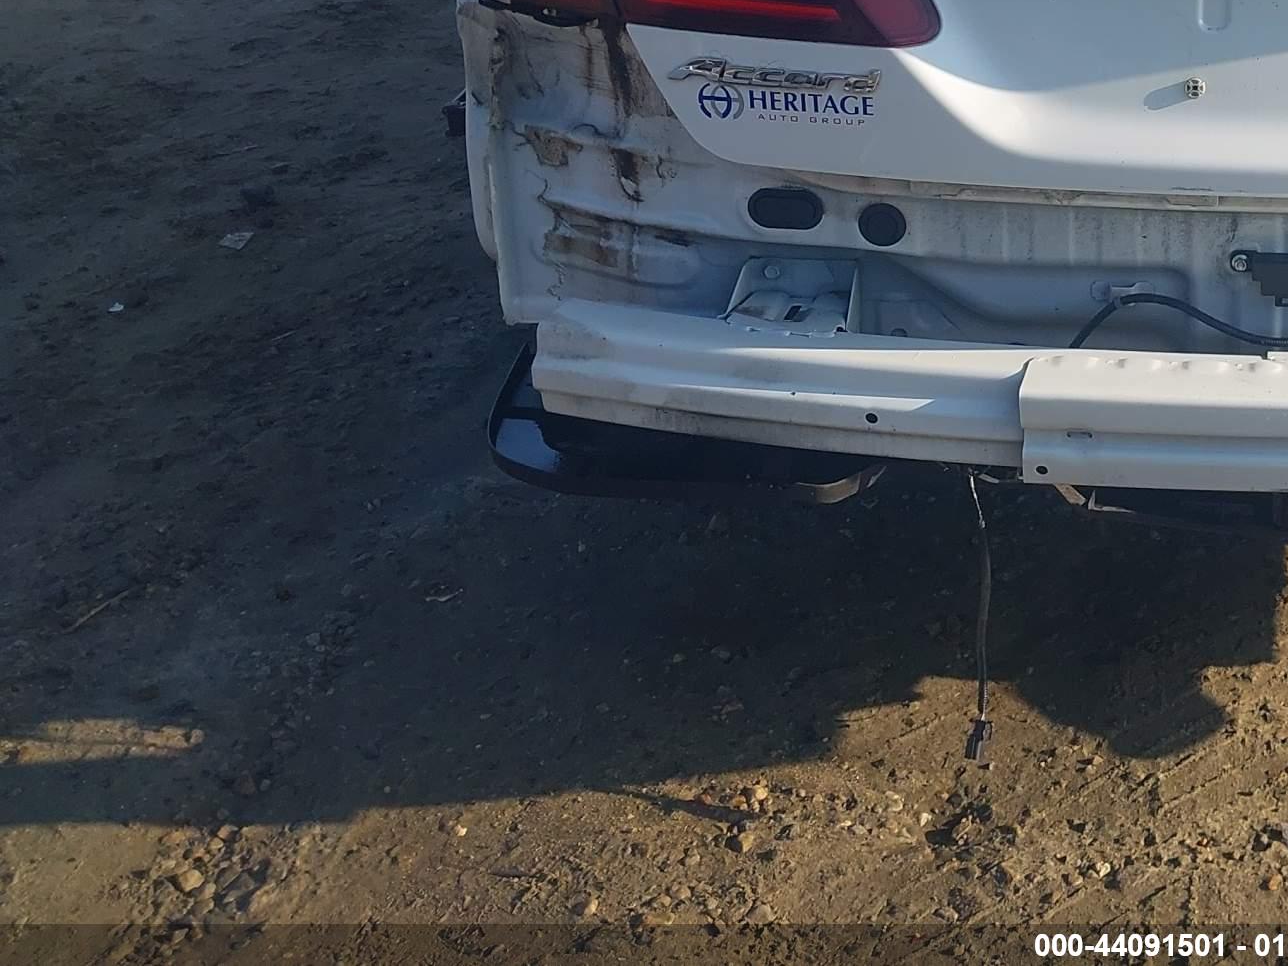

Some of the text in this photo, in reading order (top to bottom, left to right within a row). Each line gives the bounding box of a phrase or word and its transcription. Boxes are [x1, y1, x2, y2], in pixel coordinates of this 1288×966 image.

[667, 57, 882, 93] Accord
[749, 89, 875, 116] HERITAGE
[757, 113, 867, 126] AUTO GROUP
